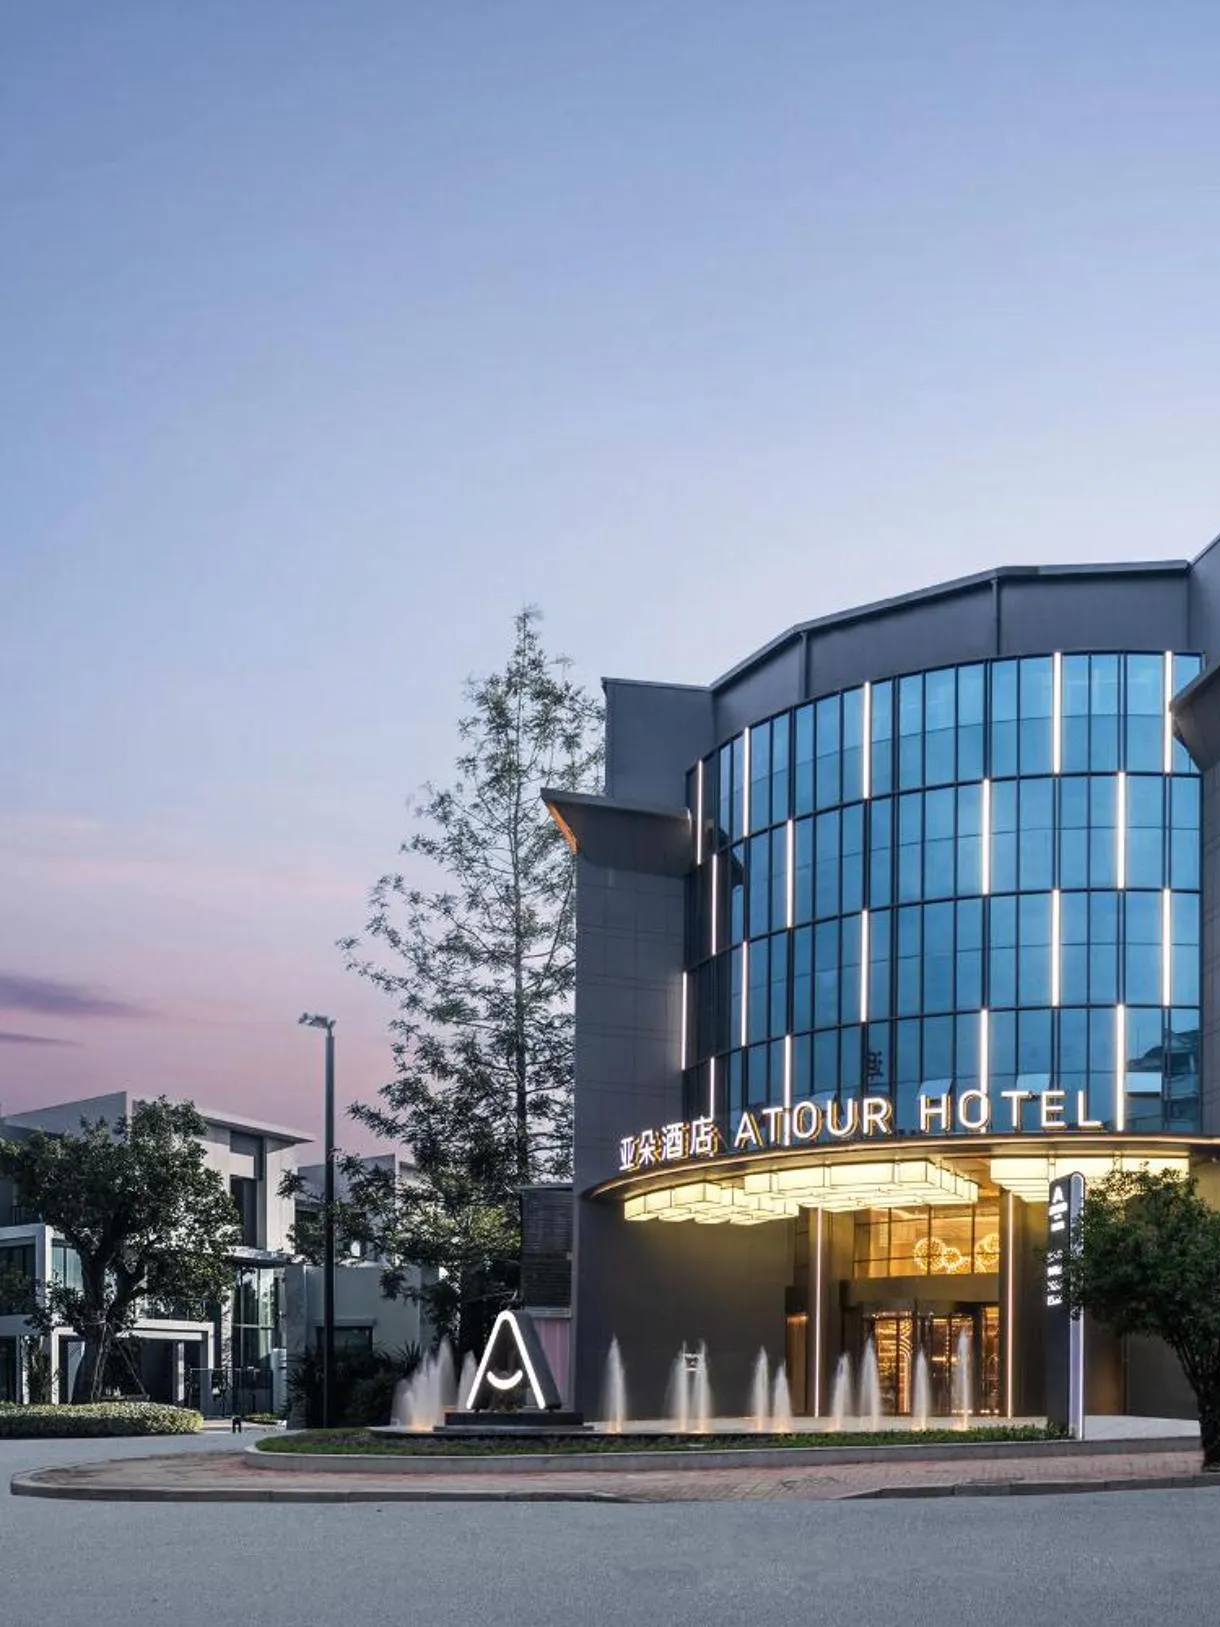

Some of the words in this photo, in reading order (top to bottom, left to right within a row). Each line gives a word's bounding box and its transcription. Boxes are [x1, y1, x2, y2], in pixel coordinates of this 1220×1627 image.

[619, 1116, 716, 1171] 亚朵酒店
[734, 1096, 894, 1148] ATOUR
[919, 1089, 1103, 1133] HOTEL
